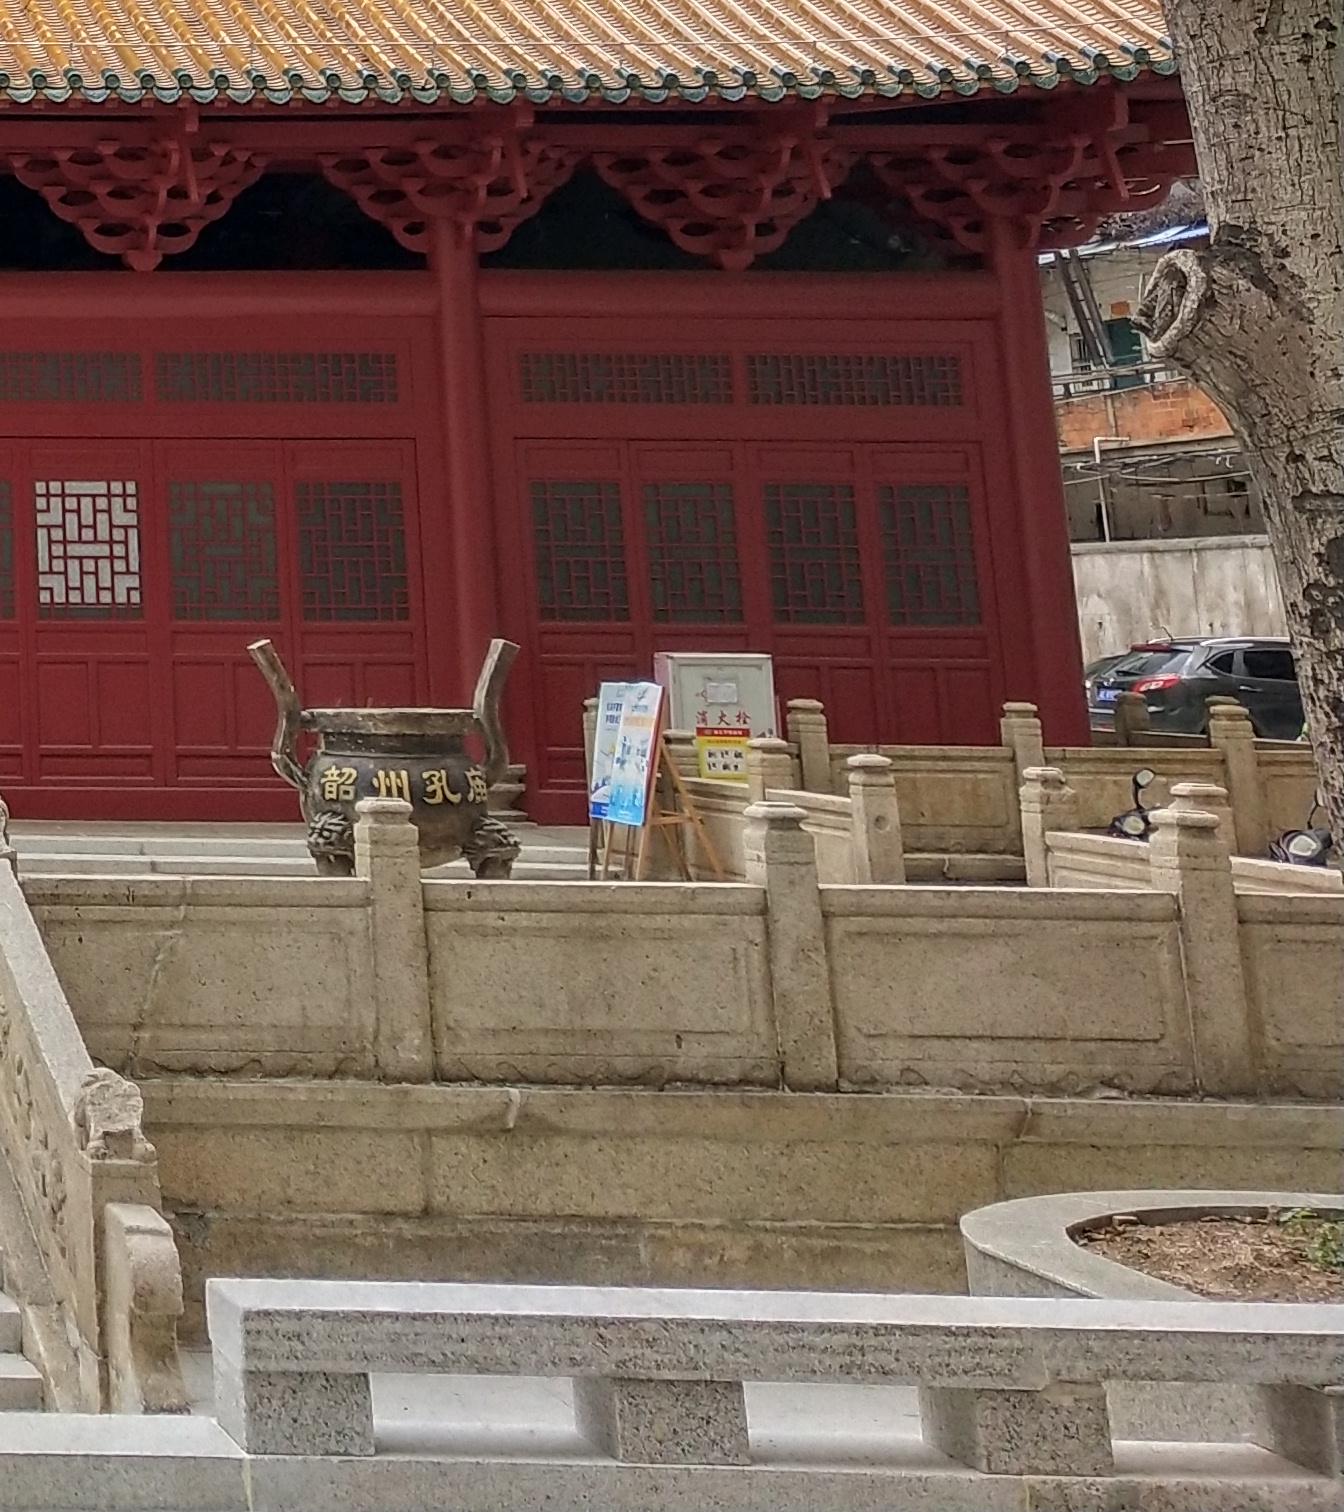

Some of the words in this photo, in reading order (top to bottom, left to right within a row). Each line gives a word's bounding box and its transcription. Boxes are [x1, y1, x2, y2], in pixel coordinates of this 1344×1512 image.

[695, 709, 751, 726] 消火栓
[320, 764, 487, 806] 韶州孔庙
